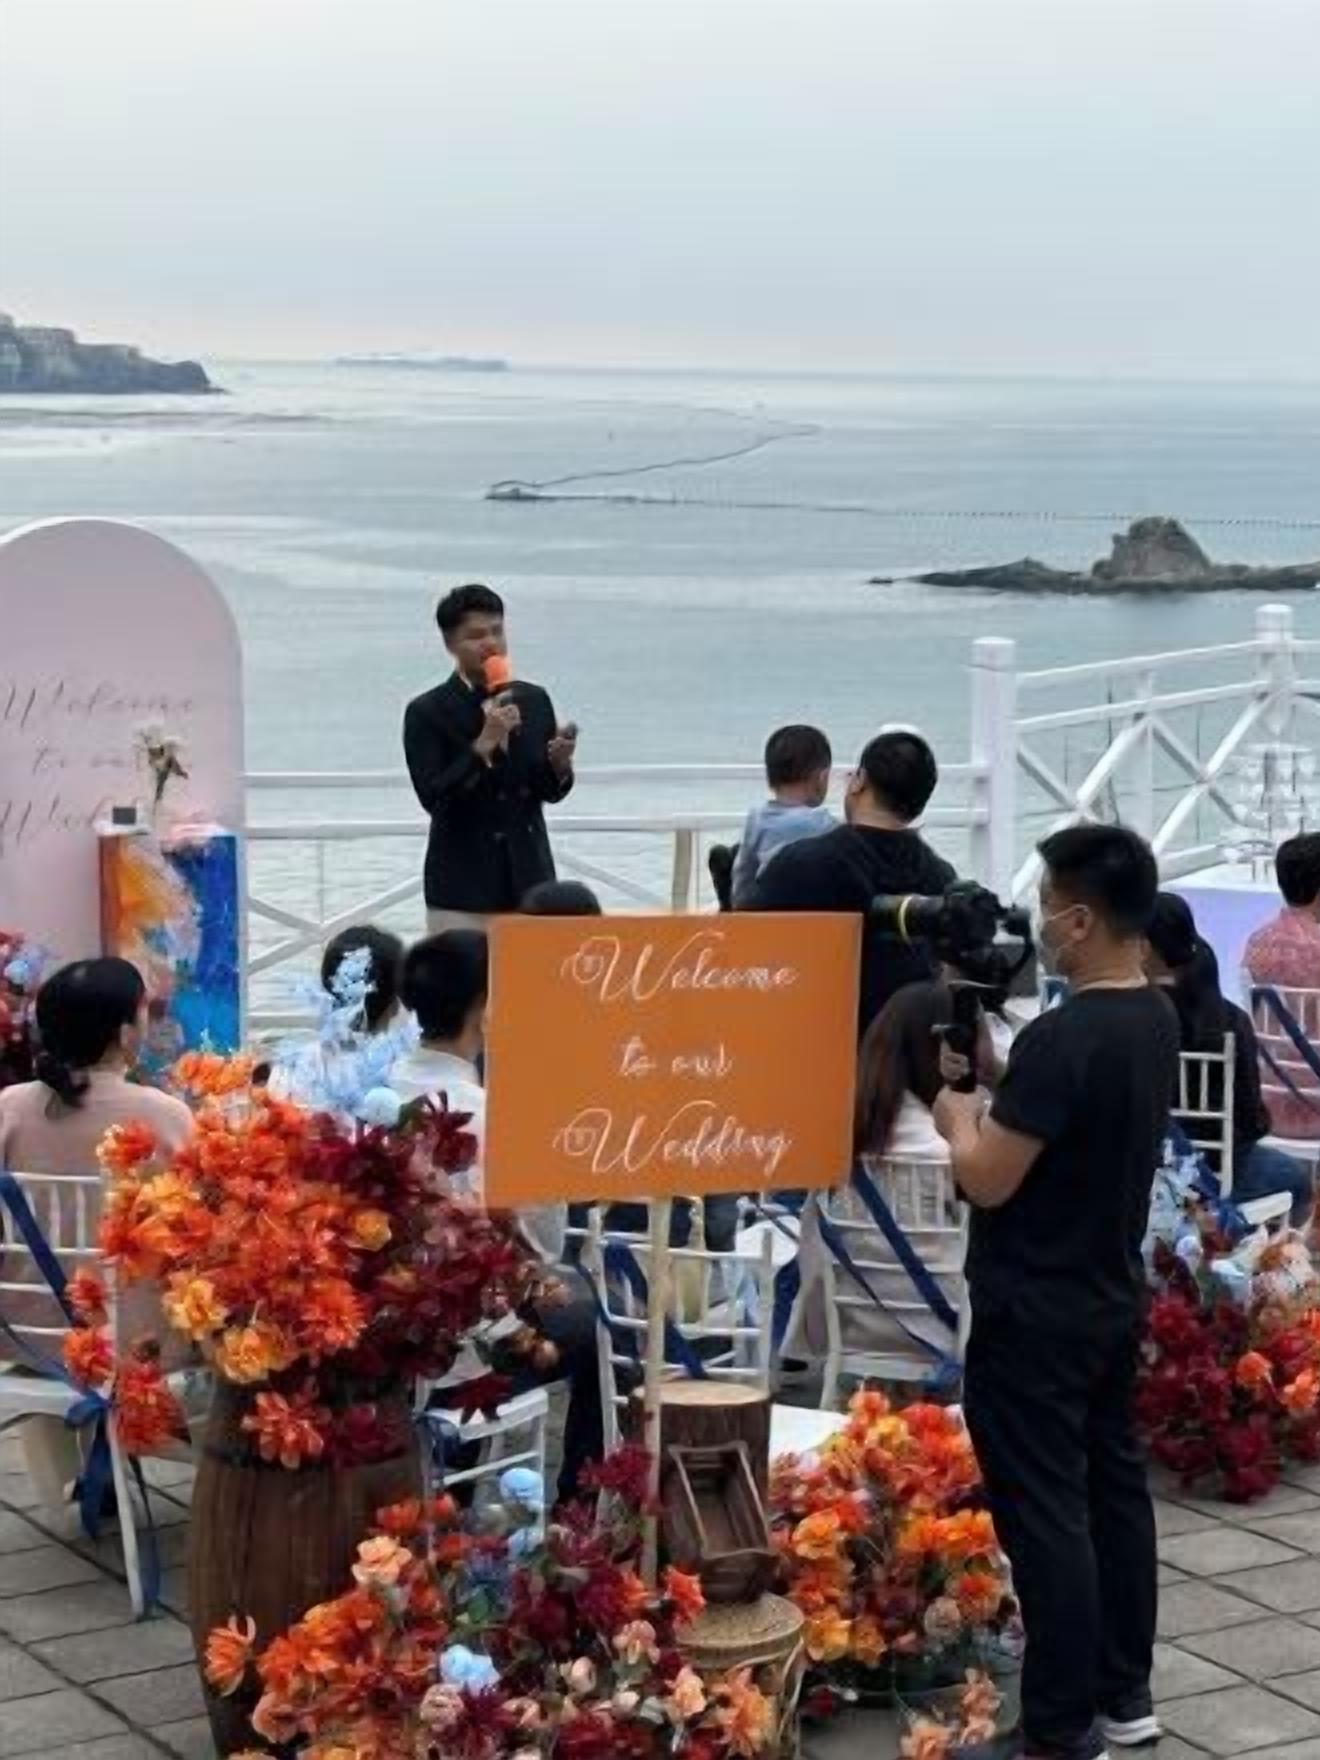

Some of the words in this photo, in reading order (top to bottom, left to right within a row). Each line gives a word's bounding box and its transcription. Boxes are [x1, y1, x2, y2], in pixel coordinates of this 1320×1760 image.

[560, 931, 799, 1001] Welcome
[618, 1035, 657, 1077] to
[553, 1100, 793, 1176] Wedding
